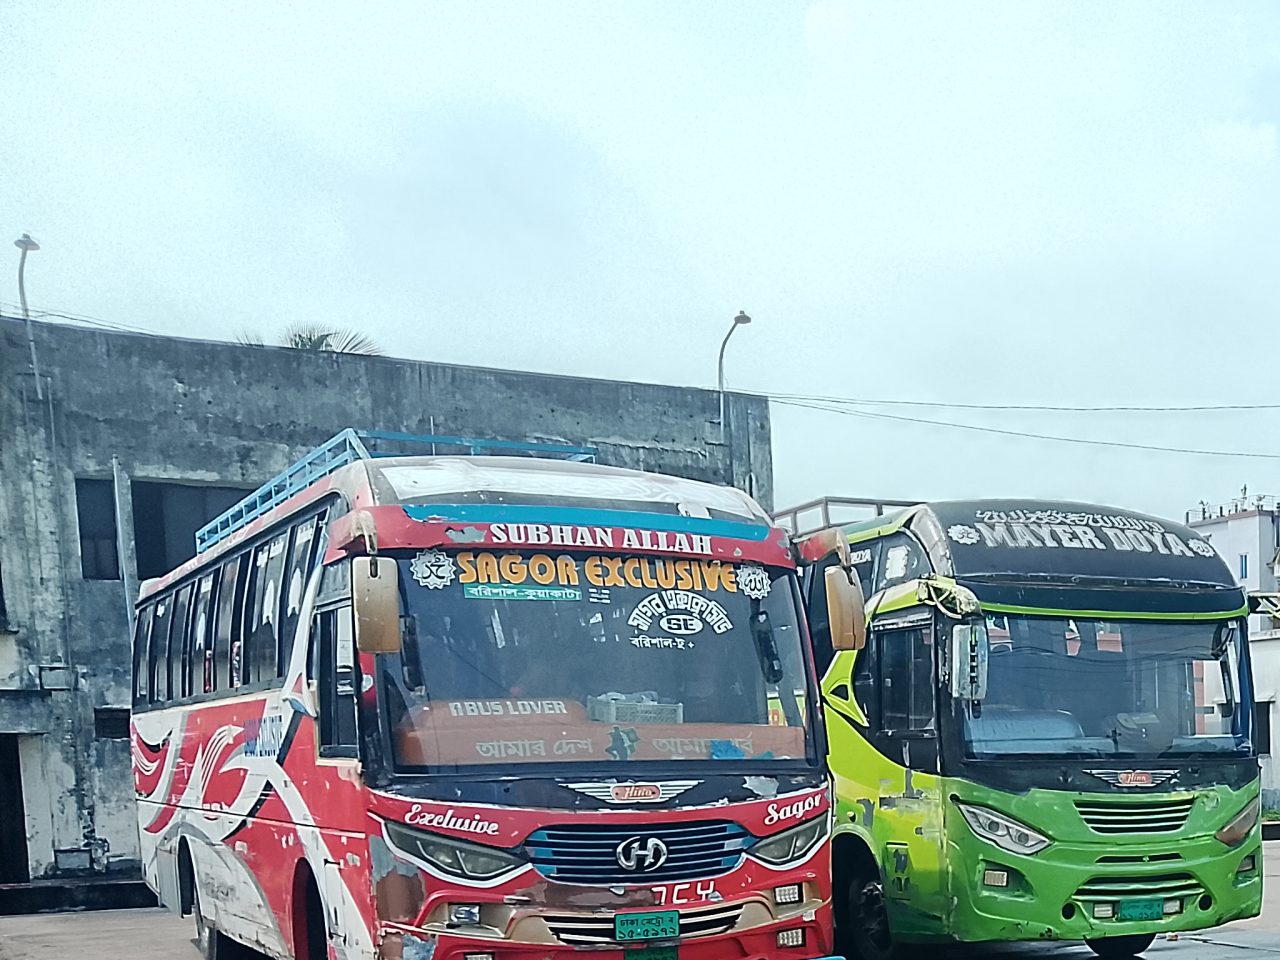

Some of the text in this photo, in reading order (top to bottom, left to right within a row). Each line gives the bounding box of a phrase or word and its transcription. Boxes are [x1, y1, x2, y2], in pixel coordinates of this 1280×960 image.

[490, 522, 713, 554] SUBHAN ALLAH
[974, 522, 1107, 550] MAYER
[1102, 527, 1195, 557] DOYA
[457, 551, 739, 592] SAGOR EXCLUSIVE
[464, 701, 504, 716] BUS
[506, 700, 568, 715] LOVER
[475, 738, 593, 758] আমার দেশ
[404, 803, 500, 835] Exclusive
[764, 793, 822, 826] Sagor
